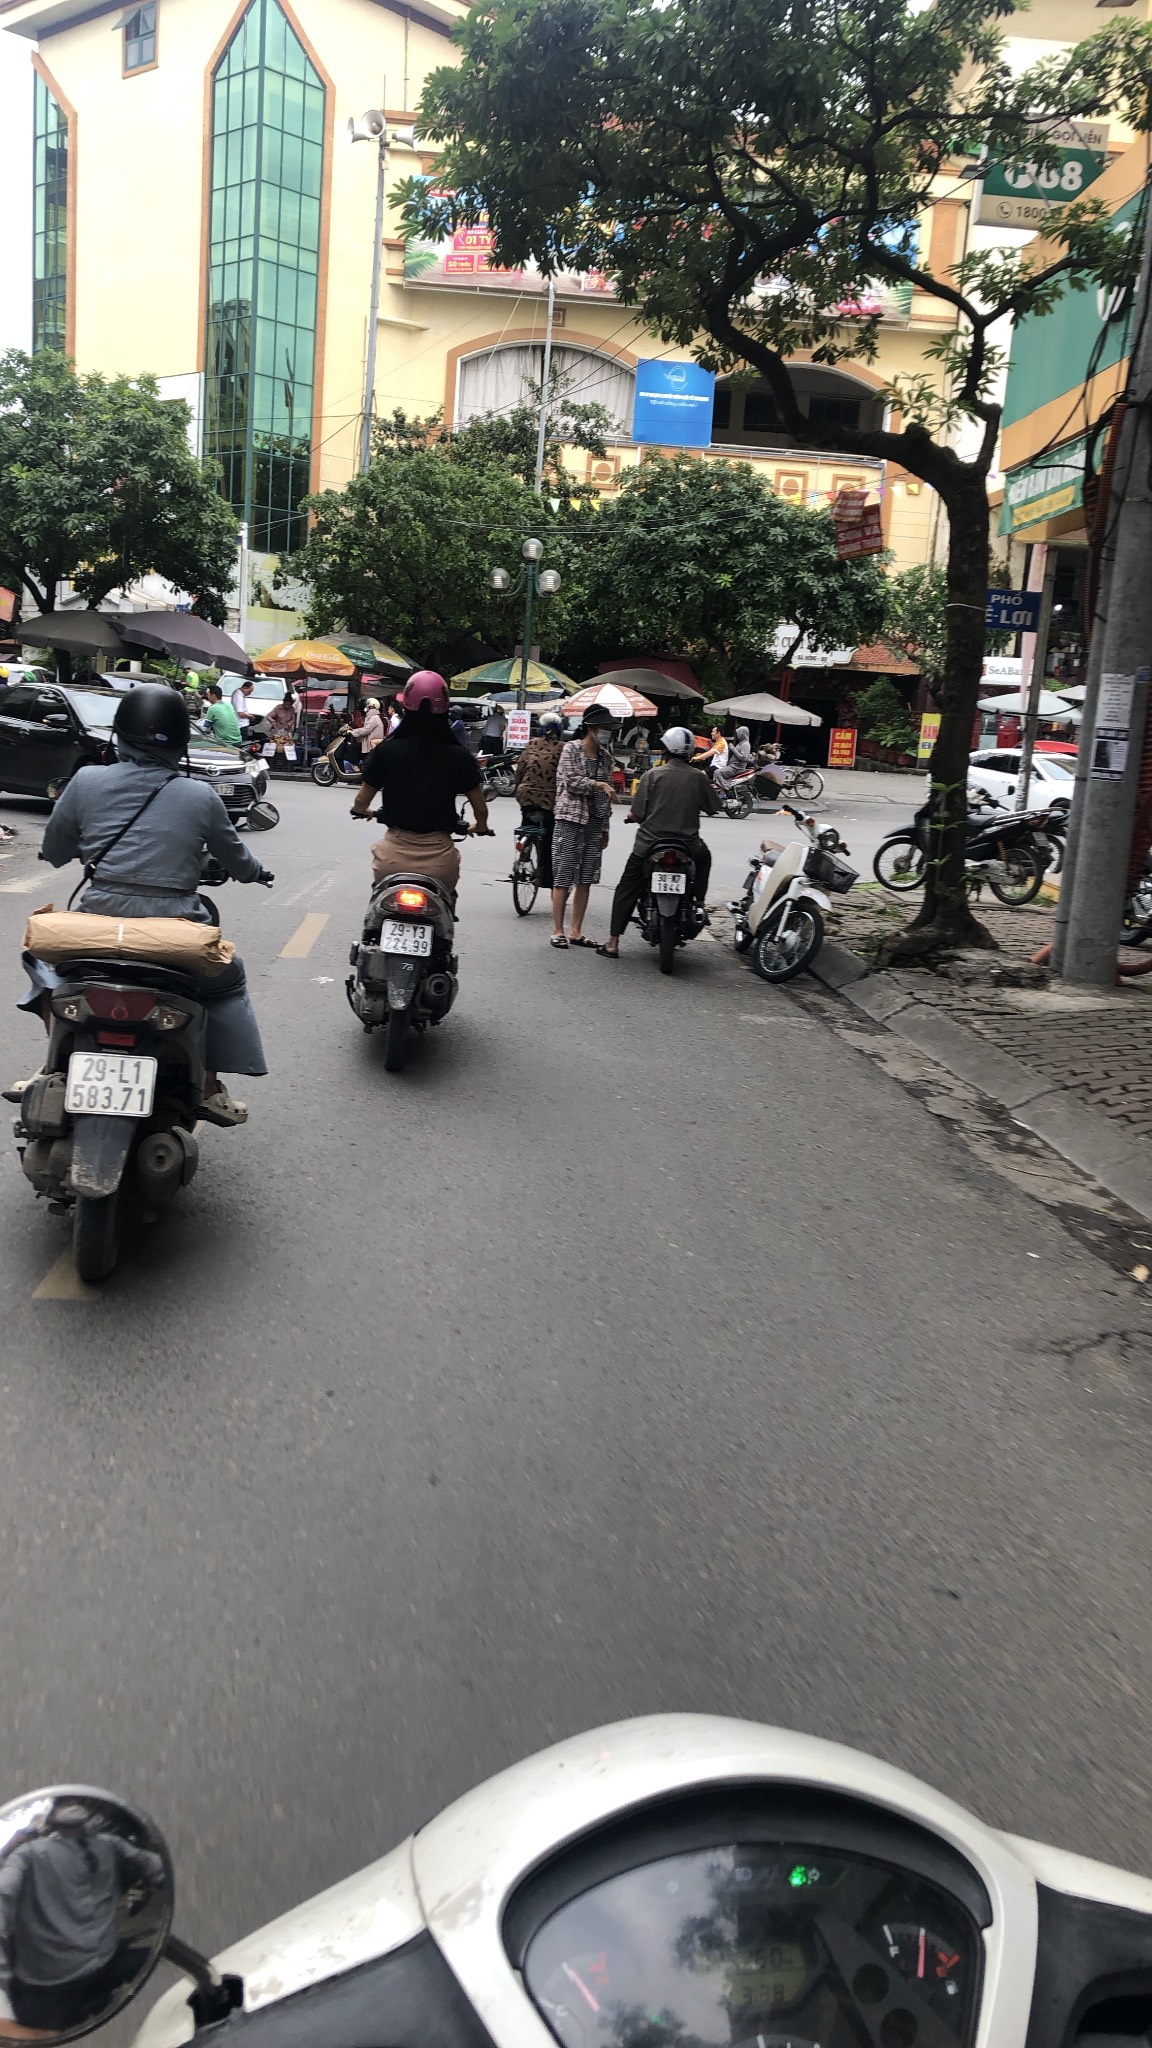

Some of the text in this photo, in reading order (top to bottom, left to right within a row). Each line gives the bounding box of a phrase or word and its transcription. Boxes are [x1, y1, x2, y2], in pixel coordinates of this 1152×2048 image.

[990, 591, 1024, 606] PHỐ
[984, 604, 1033, 628] Ê-LỢI
[306, 651, 341, 662] Coca-Cola
[511, 716, 527, 725] SỬA
[835, 730, 852, 740] CẤM
[658, 883, 680, 892] 1844
[390, 923, 426, 939] 29-Y3
[385, 937, 428, 953] 224.99
[82, 1058, 142, 1084] 29-L1
[72, 1084, 146, 1112] 583.71
